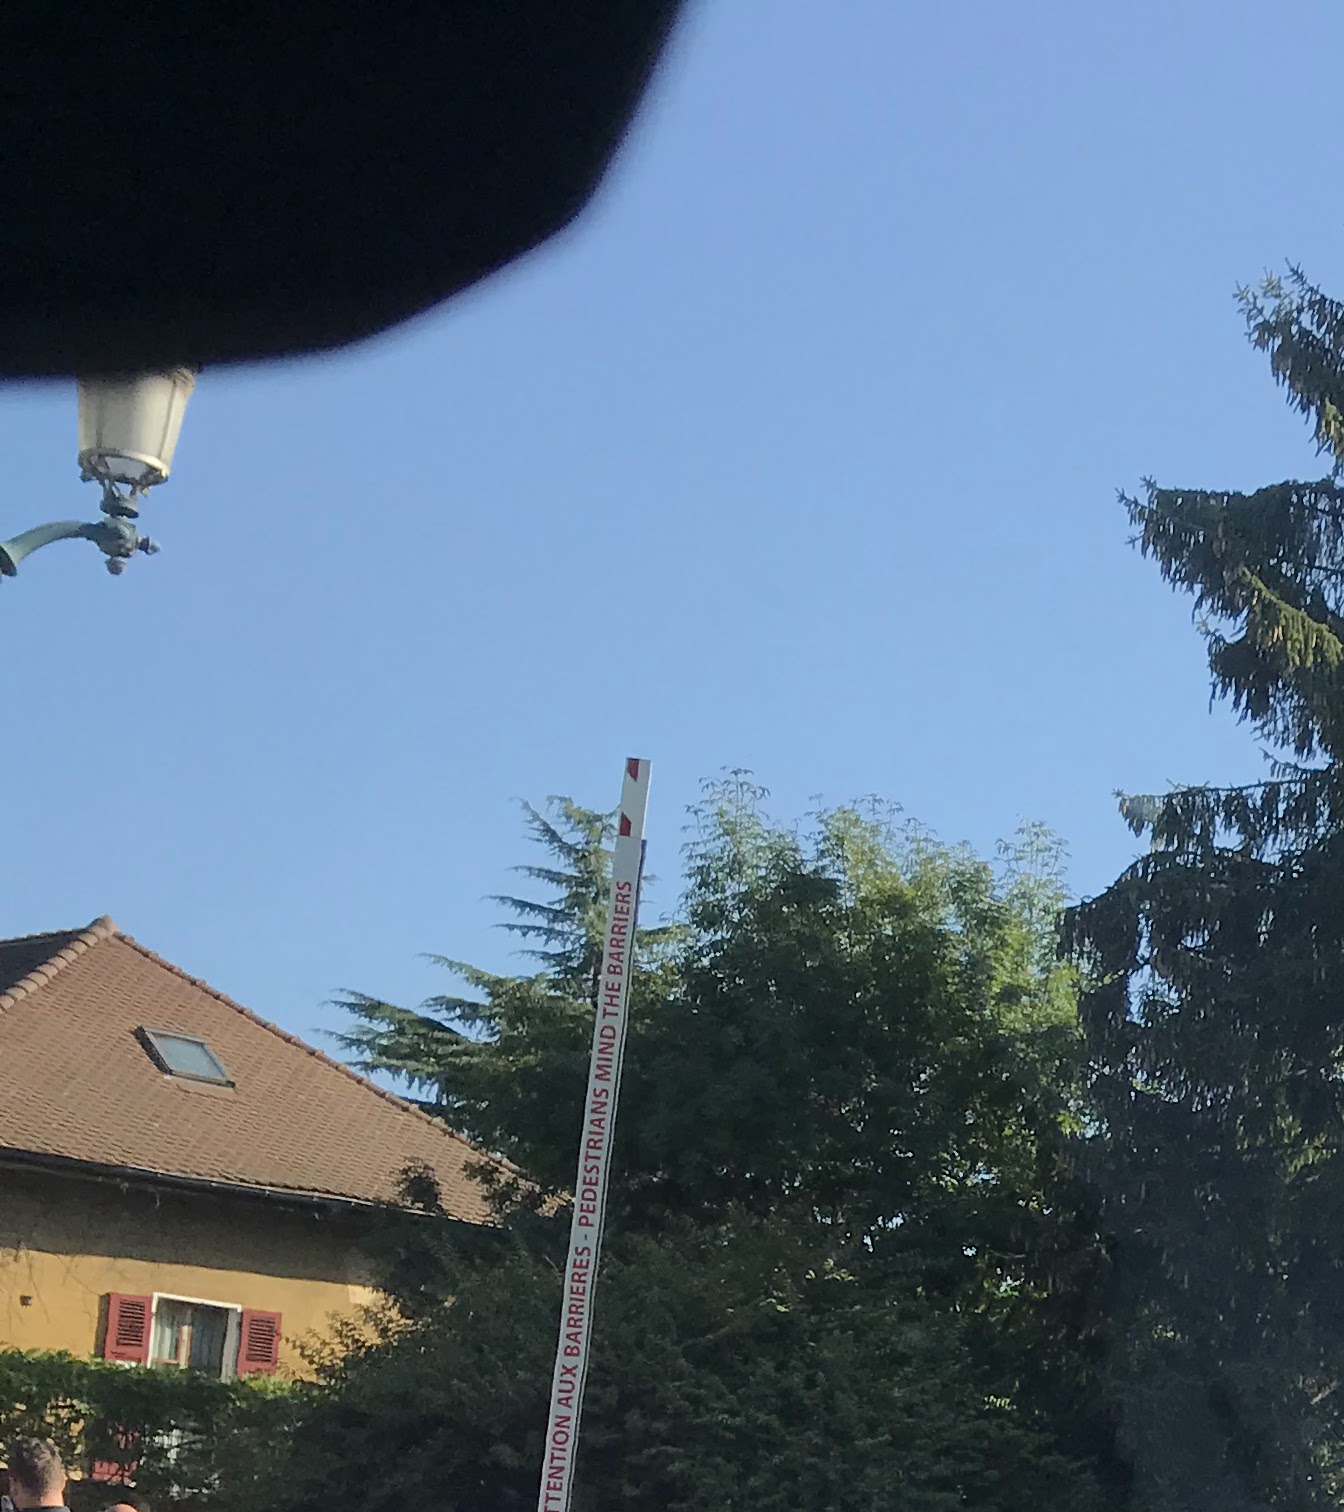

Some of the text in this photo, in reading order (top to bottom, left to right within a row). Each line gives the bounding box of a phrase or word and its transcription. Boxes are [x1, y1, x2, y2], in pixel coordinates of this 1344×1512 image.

[606, 880, 633, 975] BARRIERS
[601, 975, 622, 1019] THE
[594, 1021, 618, 1081] MIND
[577, 1087, 610, 1229] PEDESTRIANS
[563, 1245, 591, 1358] BARRIERES
[557, 1364, 579, 1409] AUX
